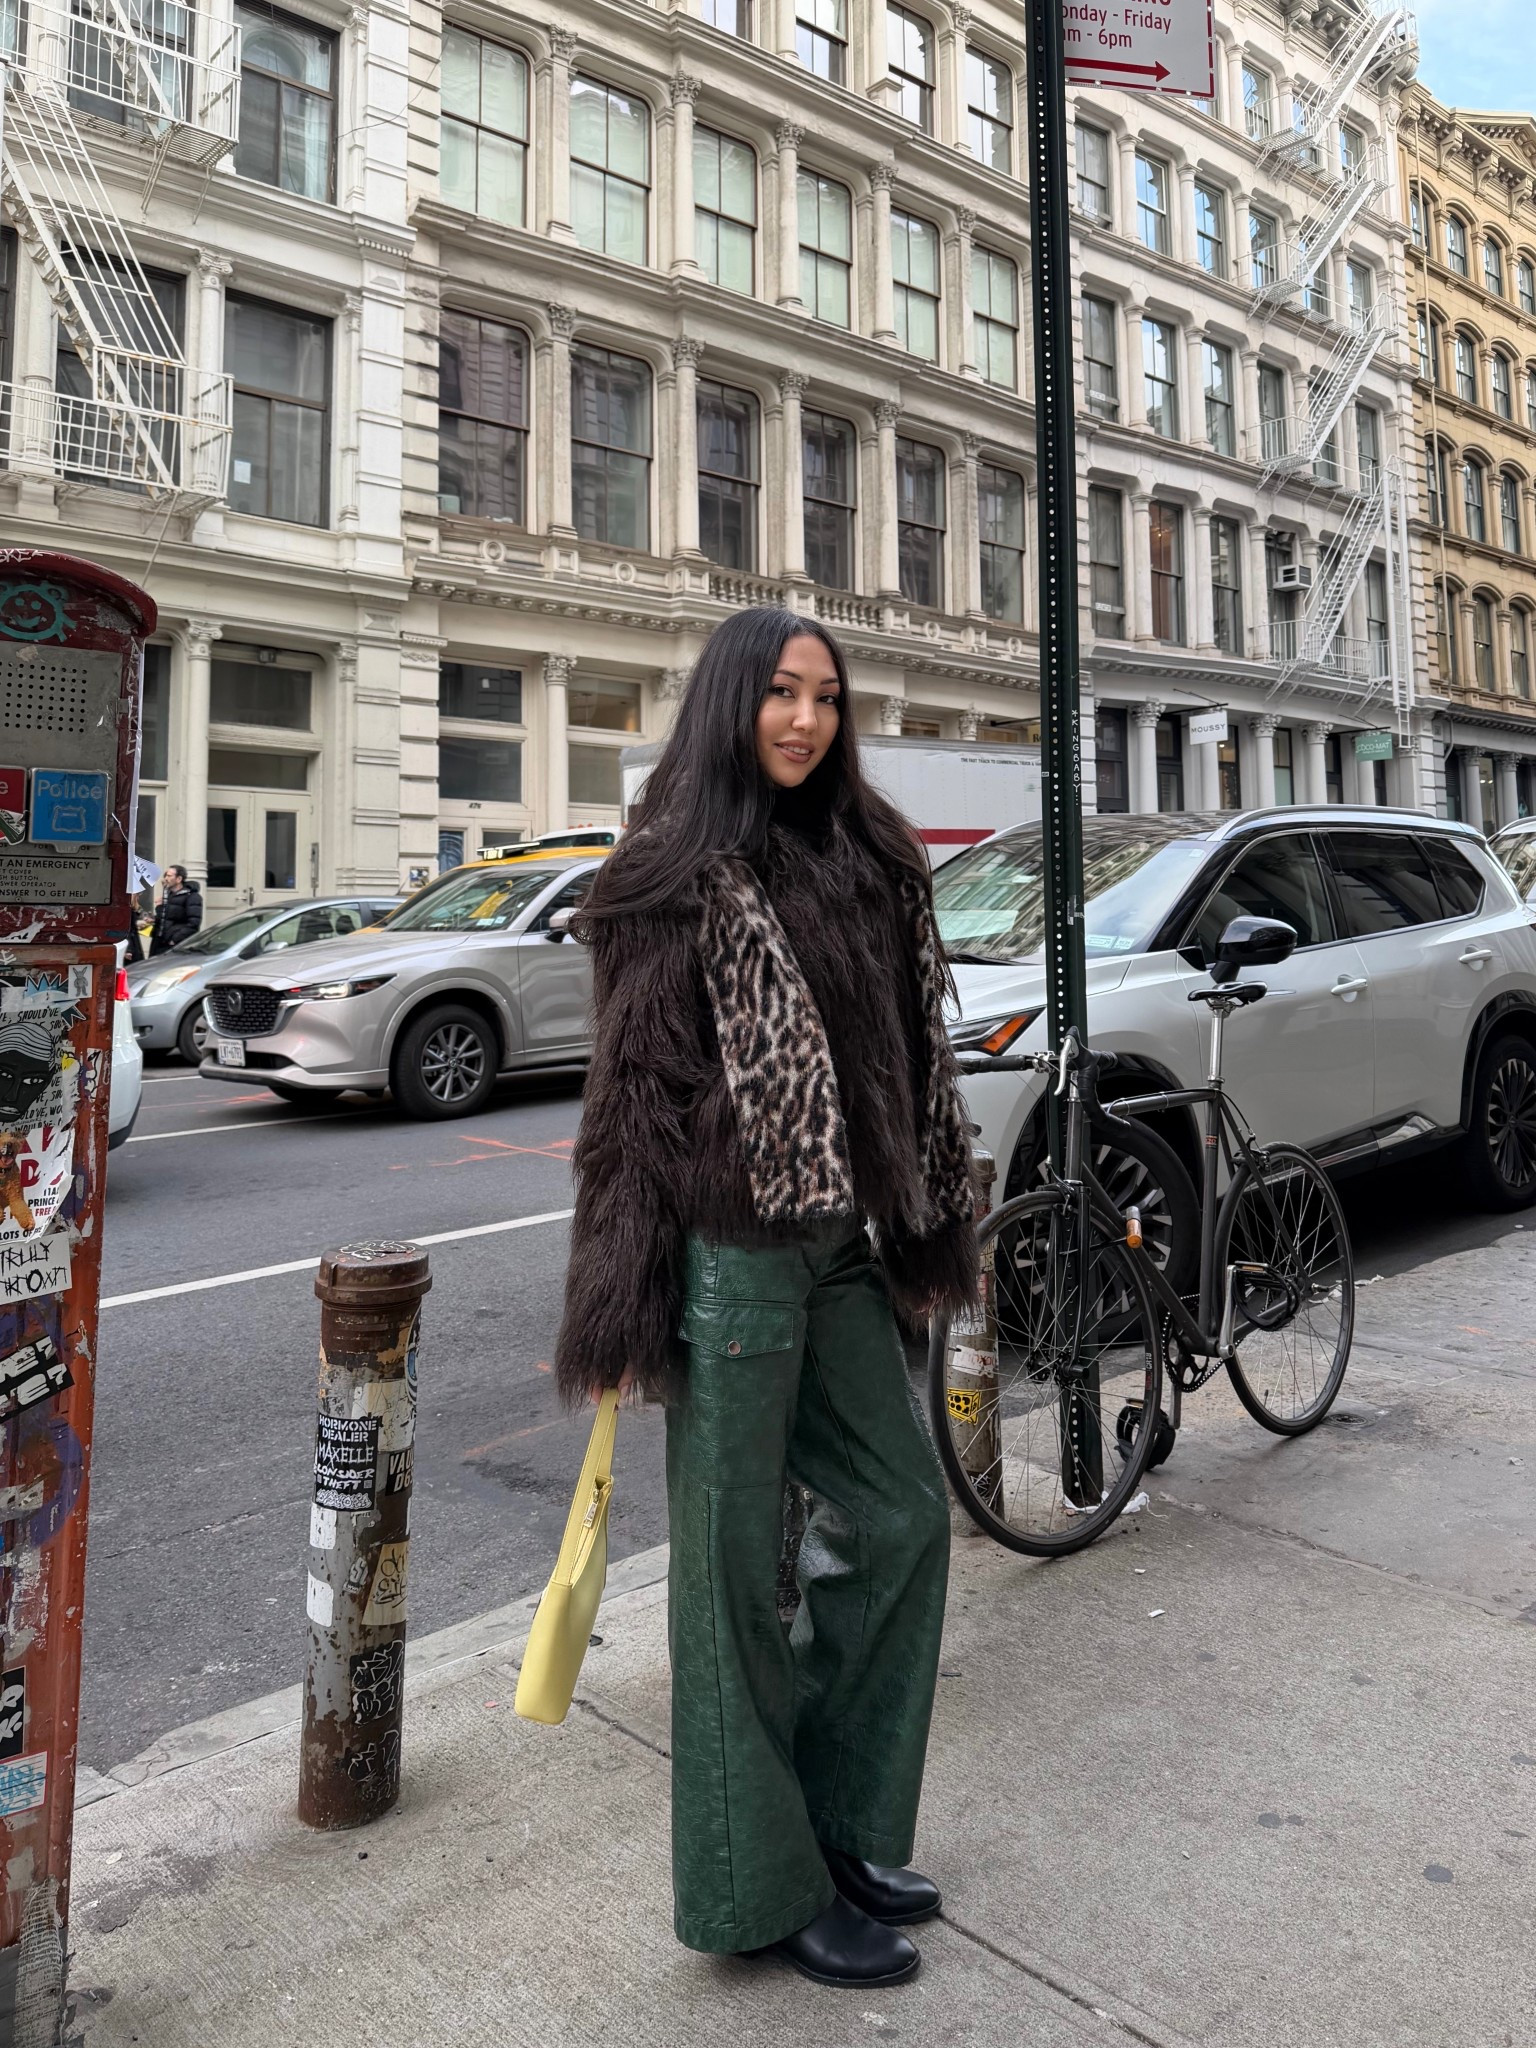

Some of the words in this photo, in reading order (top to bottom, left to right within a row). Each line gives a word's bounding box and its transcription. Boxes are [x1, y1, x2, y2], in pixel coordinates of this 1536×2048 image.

[1063, 4, 1107, 27] onday
[1124, 9, 1171, 34] Friday
[1098, 29, 1132, 49] 6pm
[1191, 723, 1226, 733] MOUSSY
[37, 779, 103, 800] Police
[7, 859, 23, 868] AN
[26, 860, 90, 870] EMERGENCY
[50, 890, 66, 898] GET
[69, 890, 89, 898] HELP
[28, 1197, 56, 1207] PRINCE
[35, 1207, 52, 1216] FREE
[319, 1414, 378, 1431] HORMONE
[322, 1427, 369, 1443] DEALER
[322, 1475, 361, 1490] THEFT
